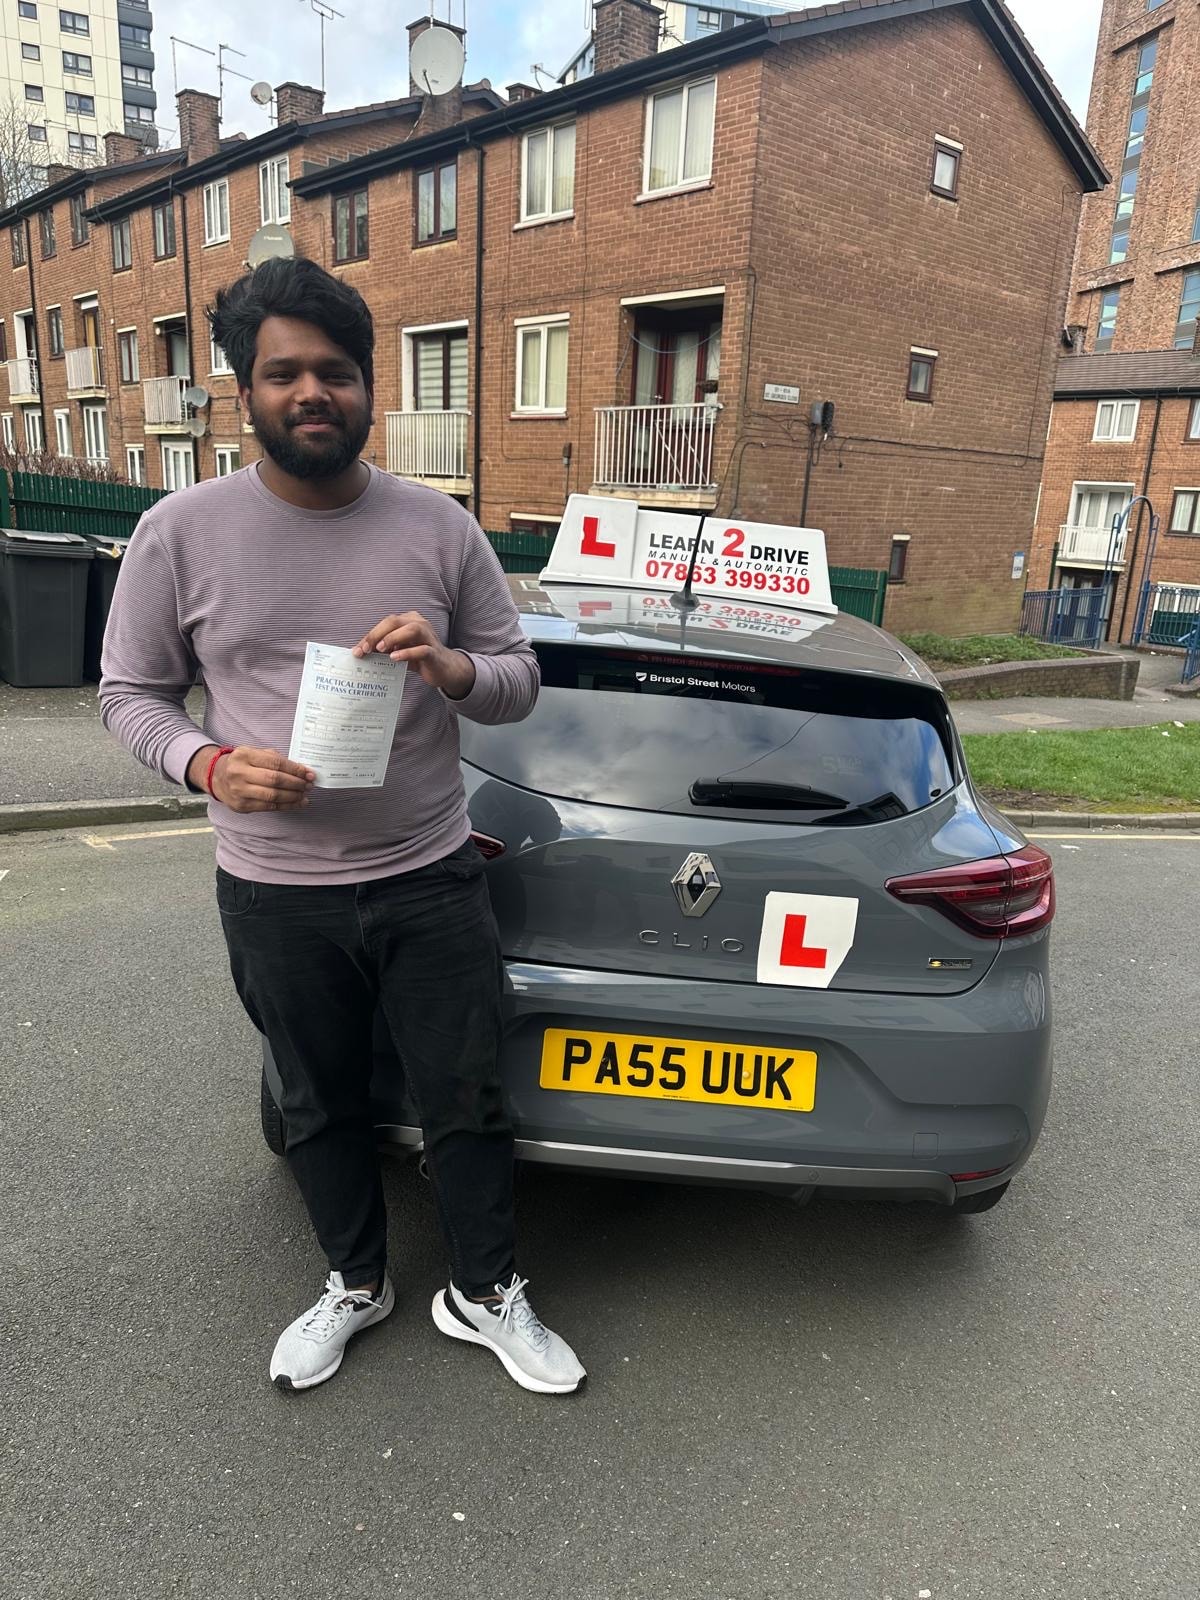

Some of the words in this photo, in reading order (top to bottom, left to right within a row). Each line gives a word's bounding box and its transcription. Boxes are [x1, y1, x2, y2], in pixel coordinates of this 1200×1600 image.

[580, 516, 615, 558] L
[649, 533, 715, 555] LEARN
[721, 528, 746, 558] 2
[750, 545, 810, 565] DRIVE
[648, 551, 707, 565] MANUL
[712, 558, 719, 566] &
[724, 559, 809, 576] AUTOMATIC
[725, 570, 811, 595] 399330
[315, 676, 356, 688] PRACTICAL
[357, 681, 389, 692] DRIVING
[315, 683, 330, 691] TEST
[330, 686, 347, 695] PASS
[348, 688, 388, 698] CERTIFICATE
[649, 674, 685, 685] Bristol
[687, 677, 720, 688] Street
[721, 681, 756, 693] Motors
[639, 929, 744, 952] CLIO
[779, 913, 828, 968] L
[562, 1037, 686, 1091] PA55
[702, 1048, 795, 1101] UUK
